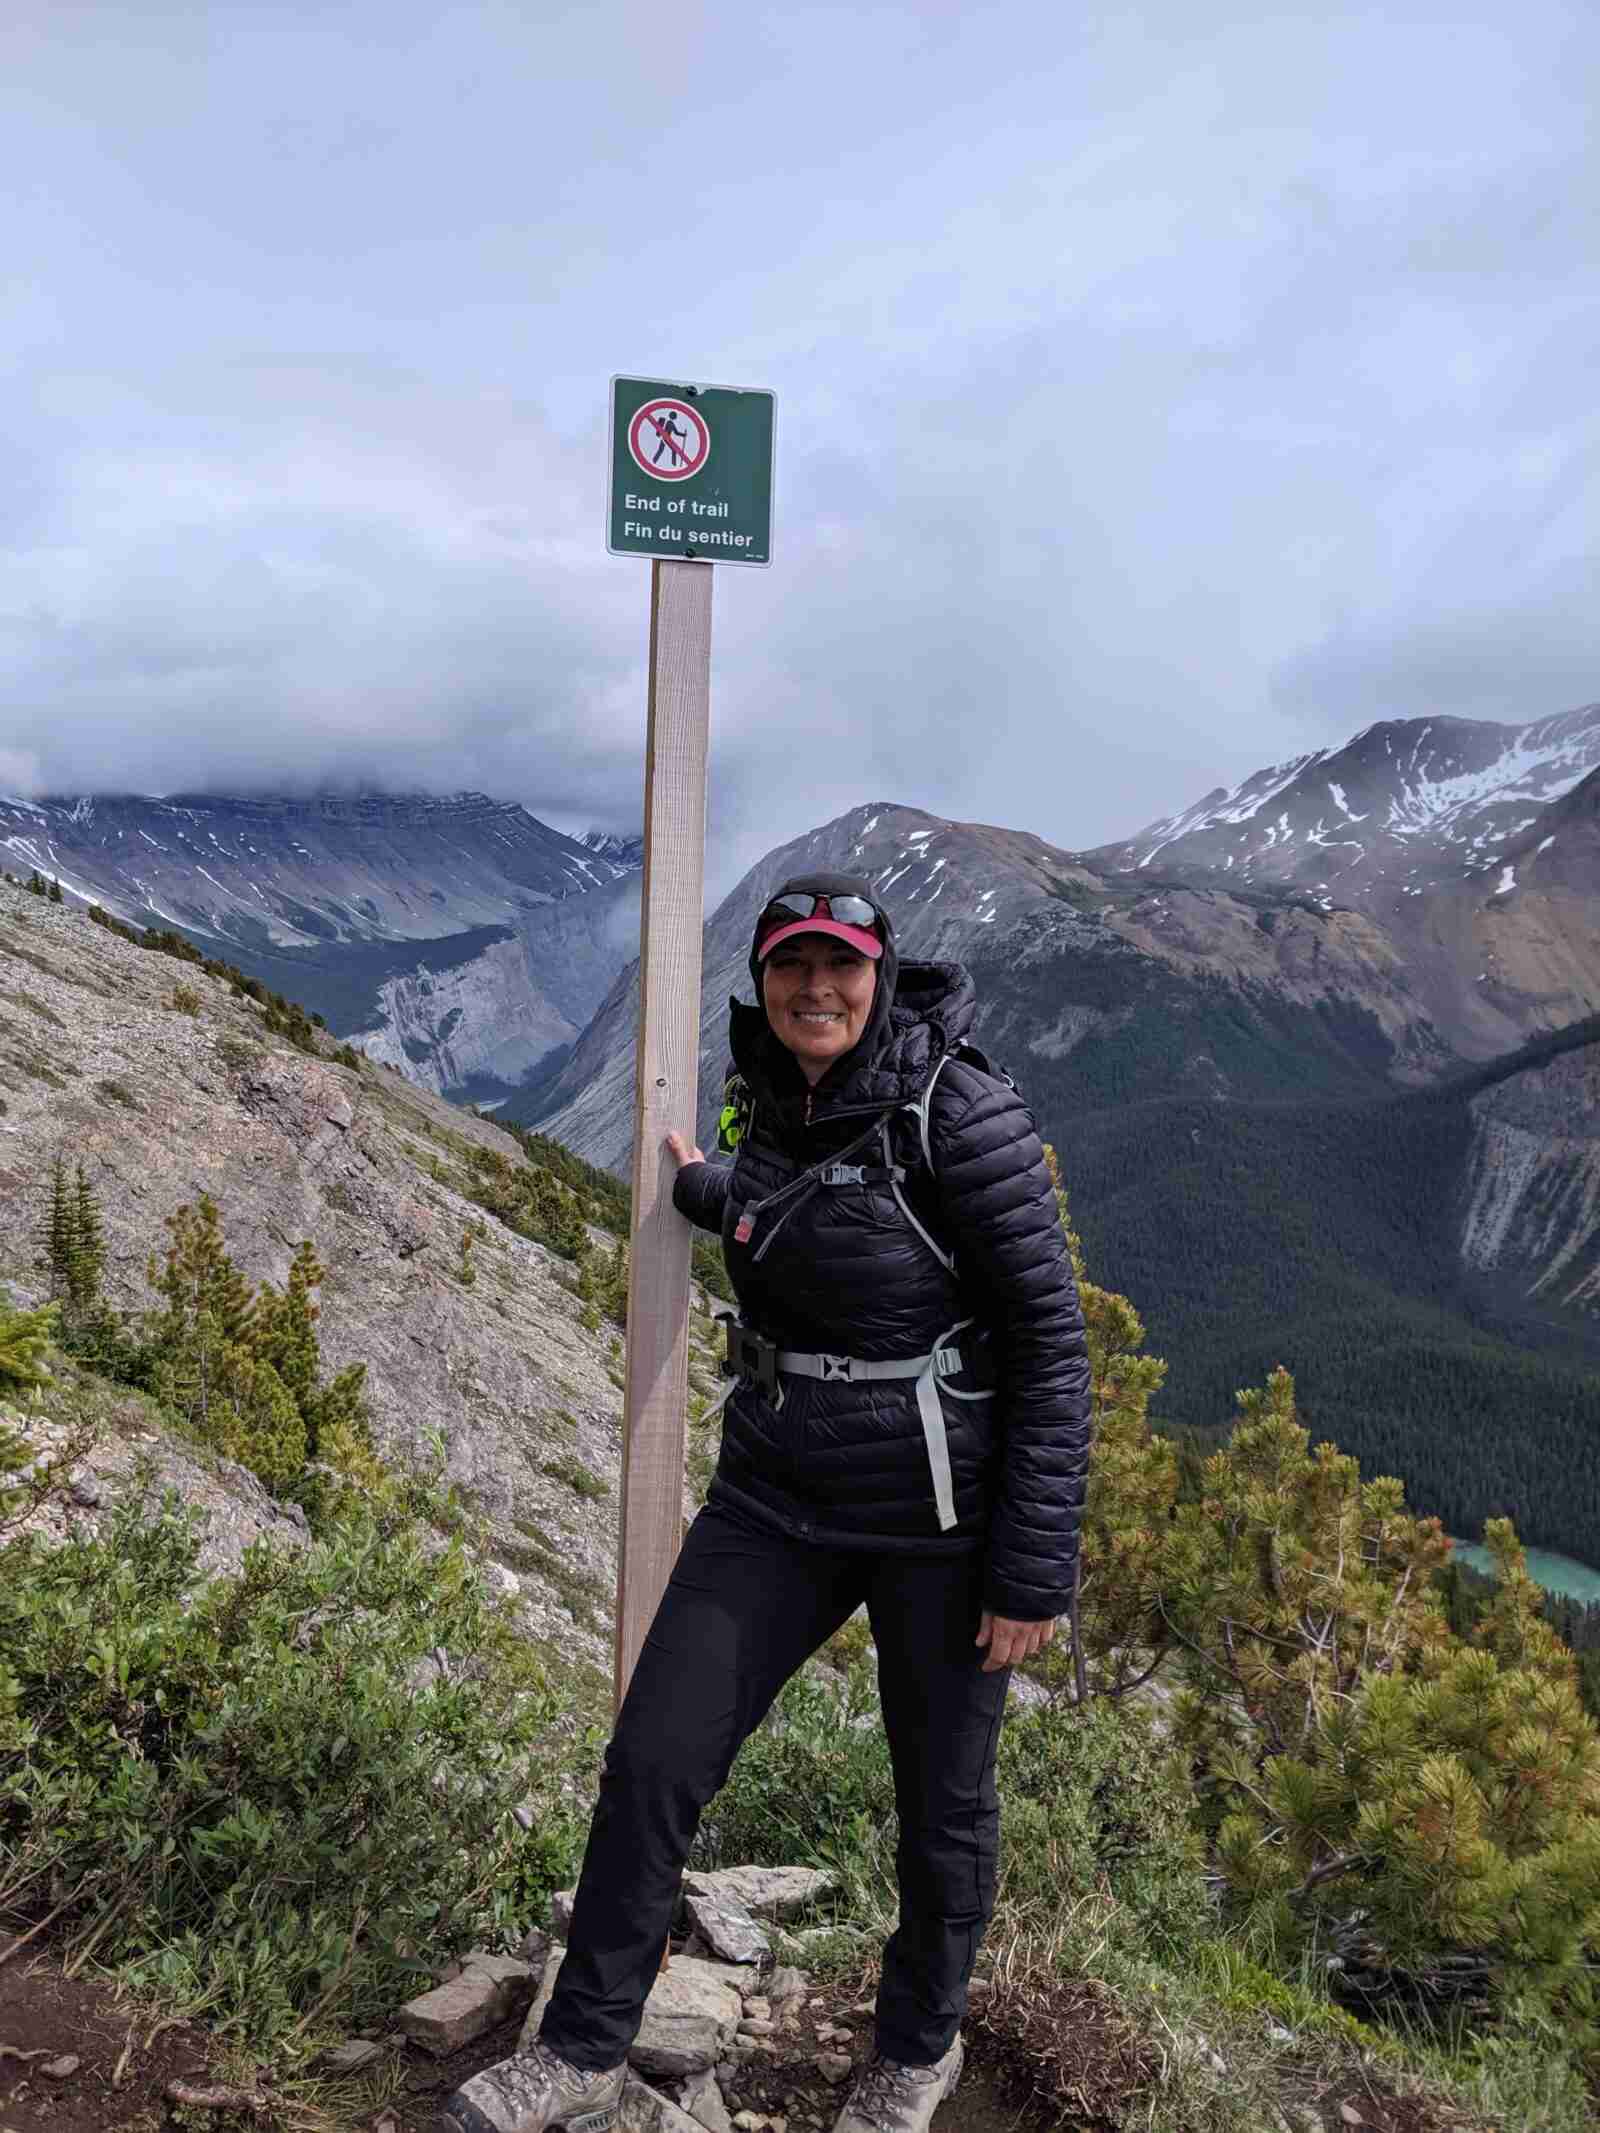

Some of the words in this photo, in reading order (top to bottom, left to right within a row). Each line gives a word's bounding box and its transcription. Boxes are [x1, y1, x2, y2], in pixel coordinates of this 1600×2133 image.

[624, 494, 660, 512] End
[667, 497, 686, 513] of
[691, 501, 729, 518] trail
[624, 522, 652, 539] Fin
[659, 525, 682, 541] du
[687, 529, 753, 547] sentier
